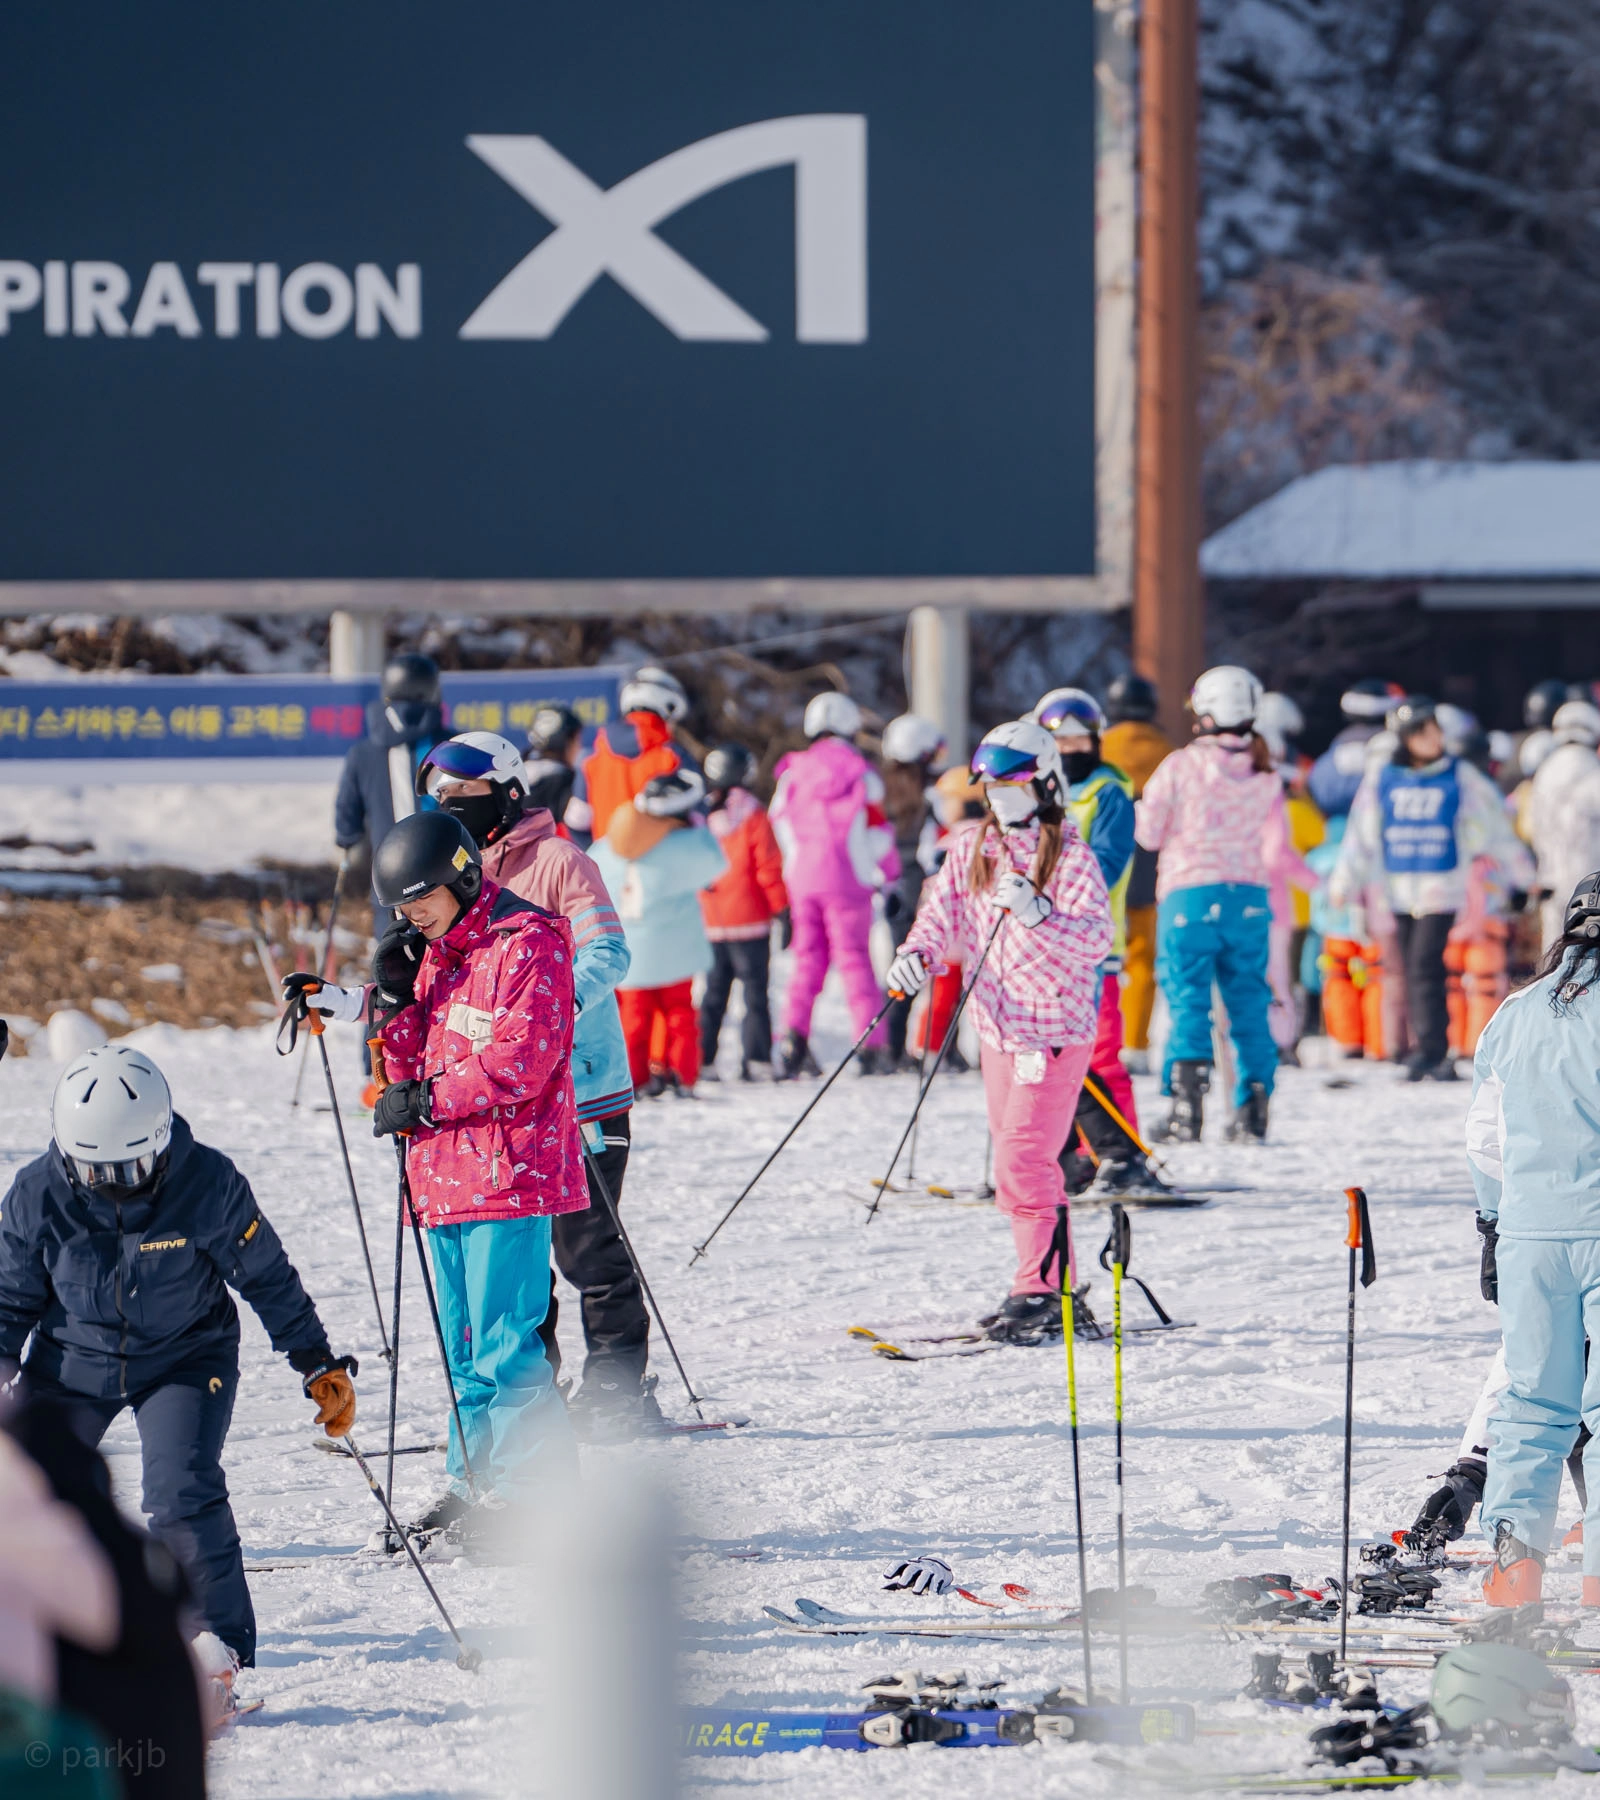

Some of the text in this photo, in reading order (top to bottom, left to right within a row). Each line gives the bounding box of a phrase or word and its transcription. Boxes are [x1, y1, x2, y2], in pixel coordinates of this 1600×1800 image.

[0, 260, 422, 338] PIRATION
[34, 704, 167, 741] 스키하우스
[169, 703, 222, 741] 이동
[227, 703, 306, 741] 고객은
[402, 880, 427, 895] ANNEX
[139, 1237, 187, 1252] CARVE
